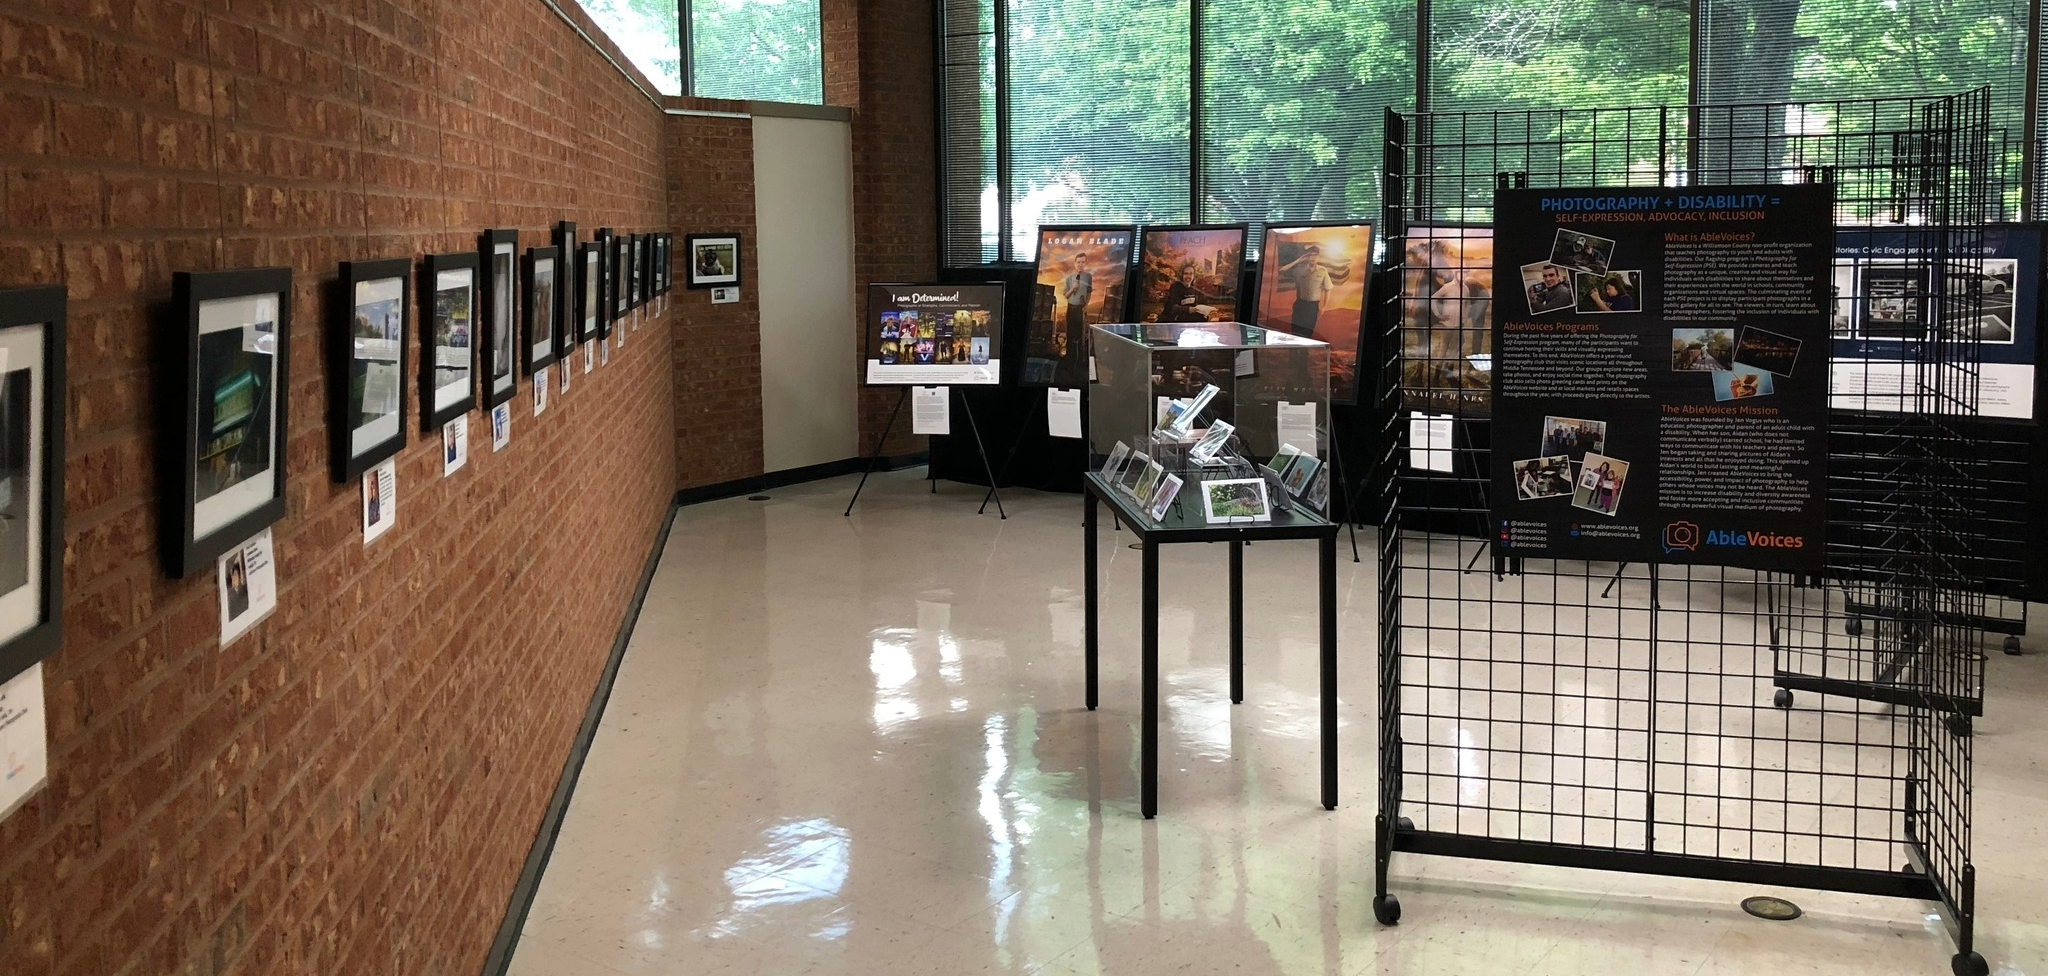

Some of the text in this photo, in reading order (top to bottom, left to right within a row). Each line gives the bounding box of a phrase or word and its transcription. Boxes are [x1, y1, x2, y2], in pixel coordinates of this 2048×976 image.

[1541, 196, 1659, 211] PHOTOGRAPHY
[1664, 199, 1673, 208] +
[1678, 195, 1766, 209] DISABILITY
[1556, 211, 1765, 223] SELF-EXPRESSION, ADVOCACY, INCLUSION
[1664, 232, 1755, 241] What is AbleVoices?
[892, 294, 896, 303] I
[912, 291, 959, 304] Determined!
[1503, 322, 1599, 332] AbleVoices Programs
[1662, 405, 1778, 415] The AbleVoices Mission
[1581, 530, 1640, 539] info@ablevoices.org
[1706, 530, 1803, 548] AbleVoices
